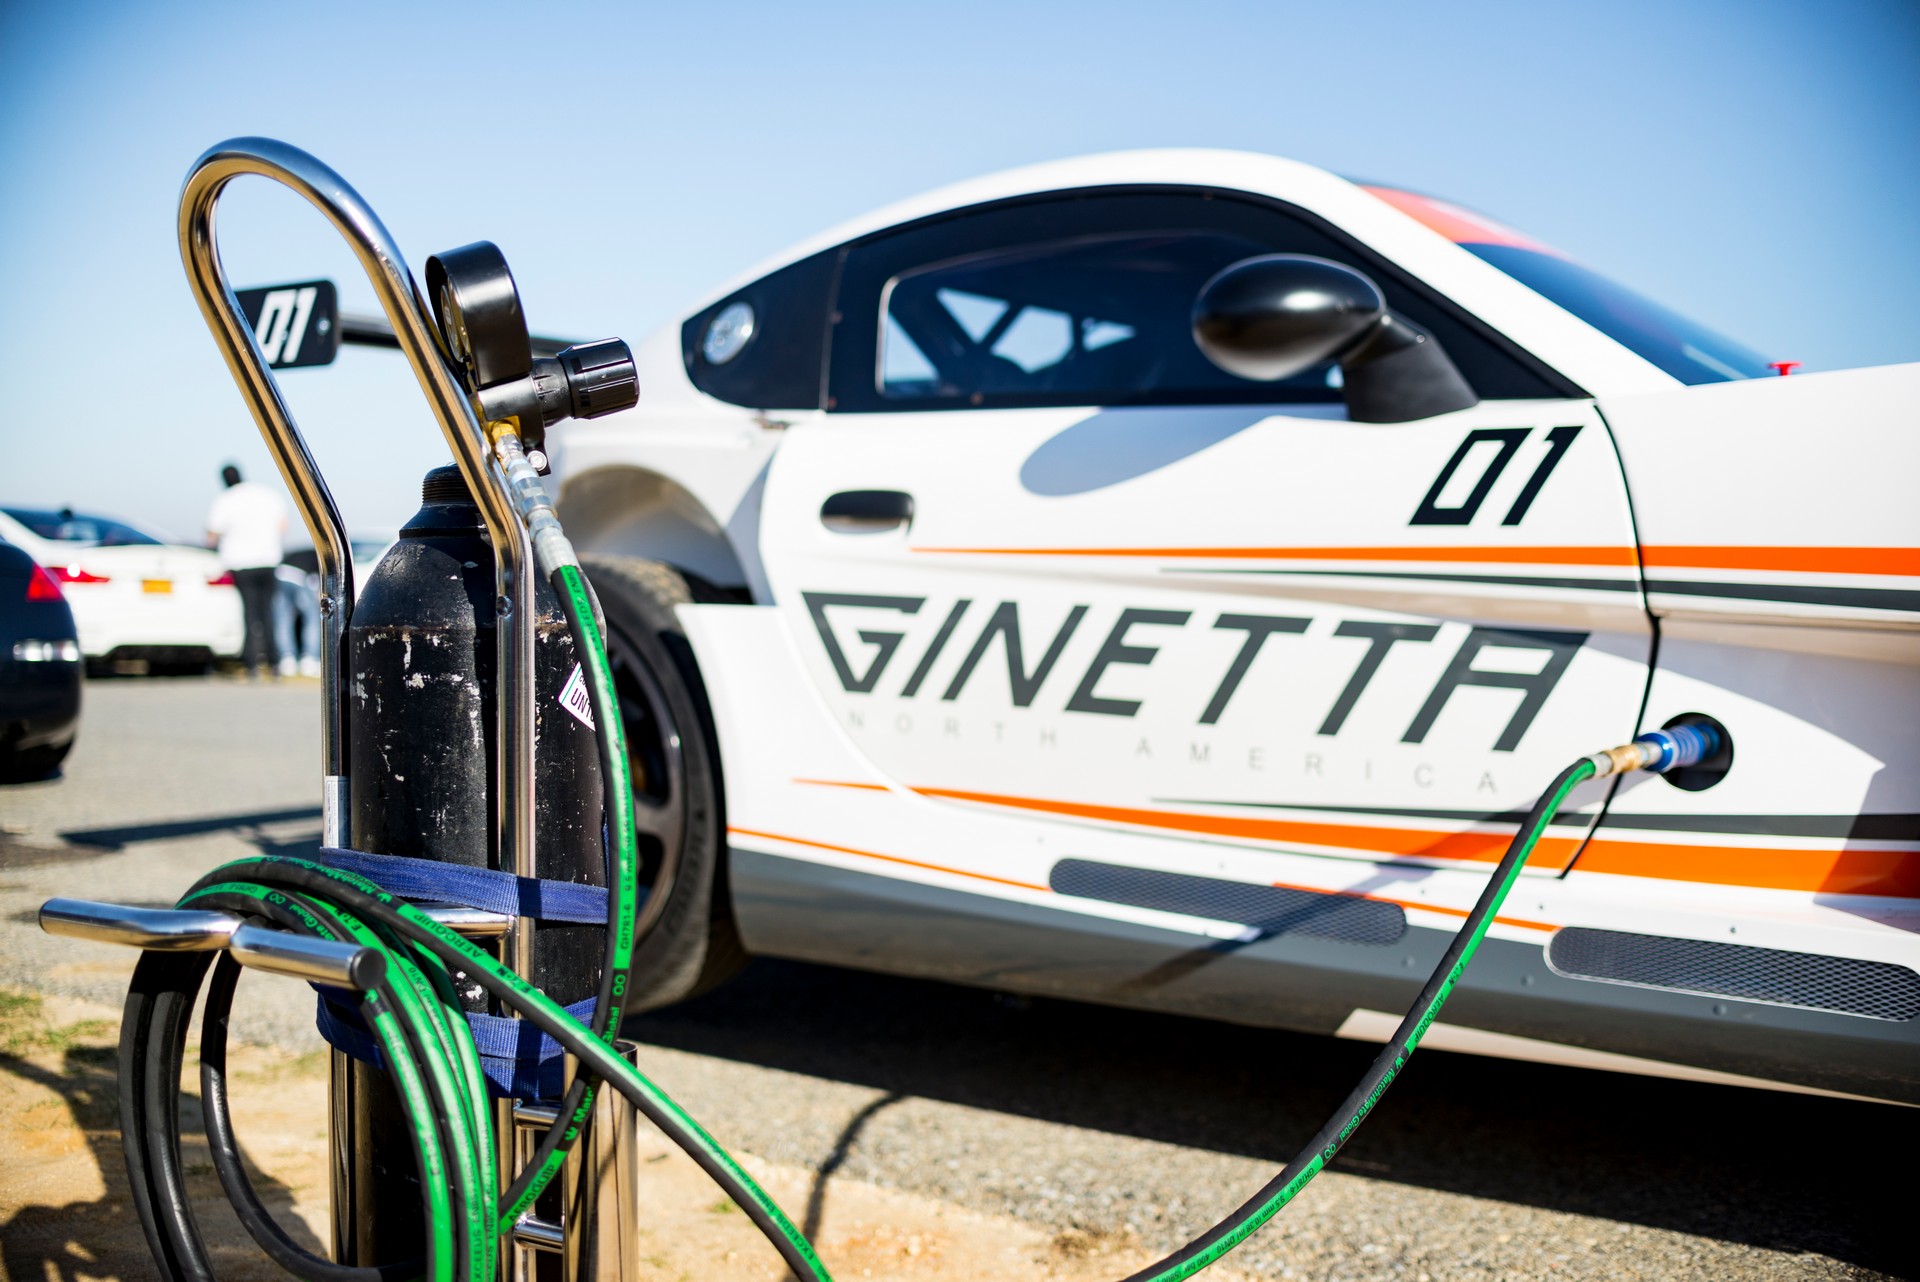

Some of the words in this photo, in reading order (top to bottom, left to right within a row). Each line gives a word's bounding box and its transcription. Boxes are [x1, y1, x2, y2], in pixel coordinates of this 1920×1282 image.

[254, 286, 318, 364] 01
[1408, 426, 1584, 526] 01
[800, 592, 1591, 751] GINETTA
[848, 711, 1058, 748] NORTH
[1135, 736, 1497, 794] AMERICA
[288, 902, 318, 929] Global
[412, 910, 483, 960] AEROQUIP
[1411, 992, 1446, 1043] AEROQUIP
[507, 1162, 557, 1222] AEROQUIP
[620, 904, 632, 949] GH781-6
[1357, 1067, 1396, 1117] MatchMate
[1337, 1114, 1361, 1142] Global
[749, 1183, 776, 1212] EN857
[1288, 1166, 1315, 1195] GH781-6
[1260, 1203, 1276, 1217] mm
[1273, 1194, 1285, 1207] 9.5
[774, 1212, 816, 1259] EXCEEDS
[1214, 1235, 1236, 1254] DN10
[1183, 1261, 1196, 1273] bar
[1196, 1253, 1210, 1266] 400
